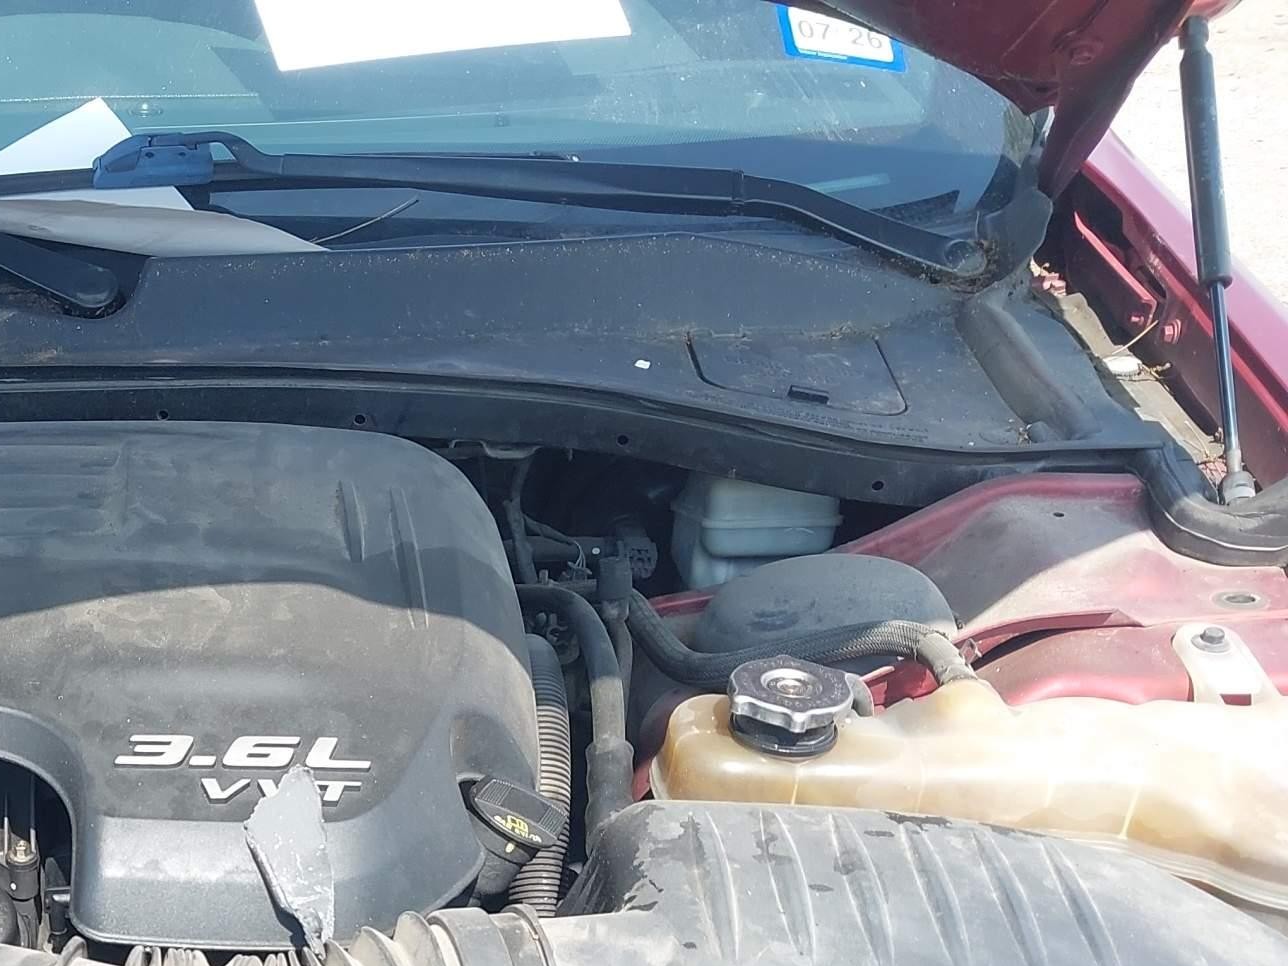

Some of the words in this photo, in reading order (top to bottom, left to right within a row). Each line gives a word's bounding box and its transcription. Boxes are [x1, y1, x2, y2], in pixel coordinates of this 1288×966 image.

[798, 20, 830, 40] 07
[848, 27, 882, 49] 26
[114, 734, 372, 771] 3.6L
